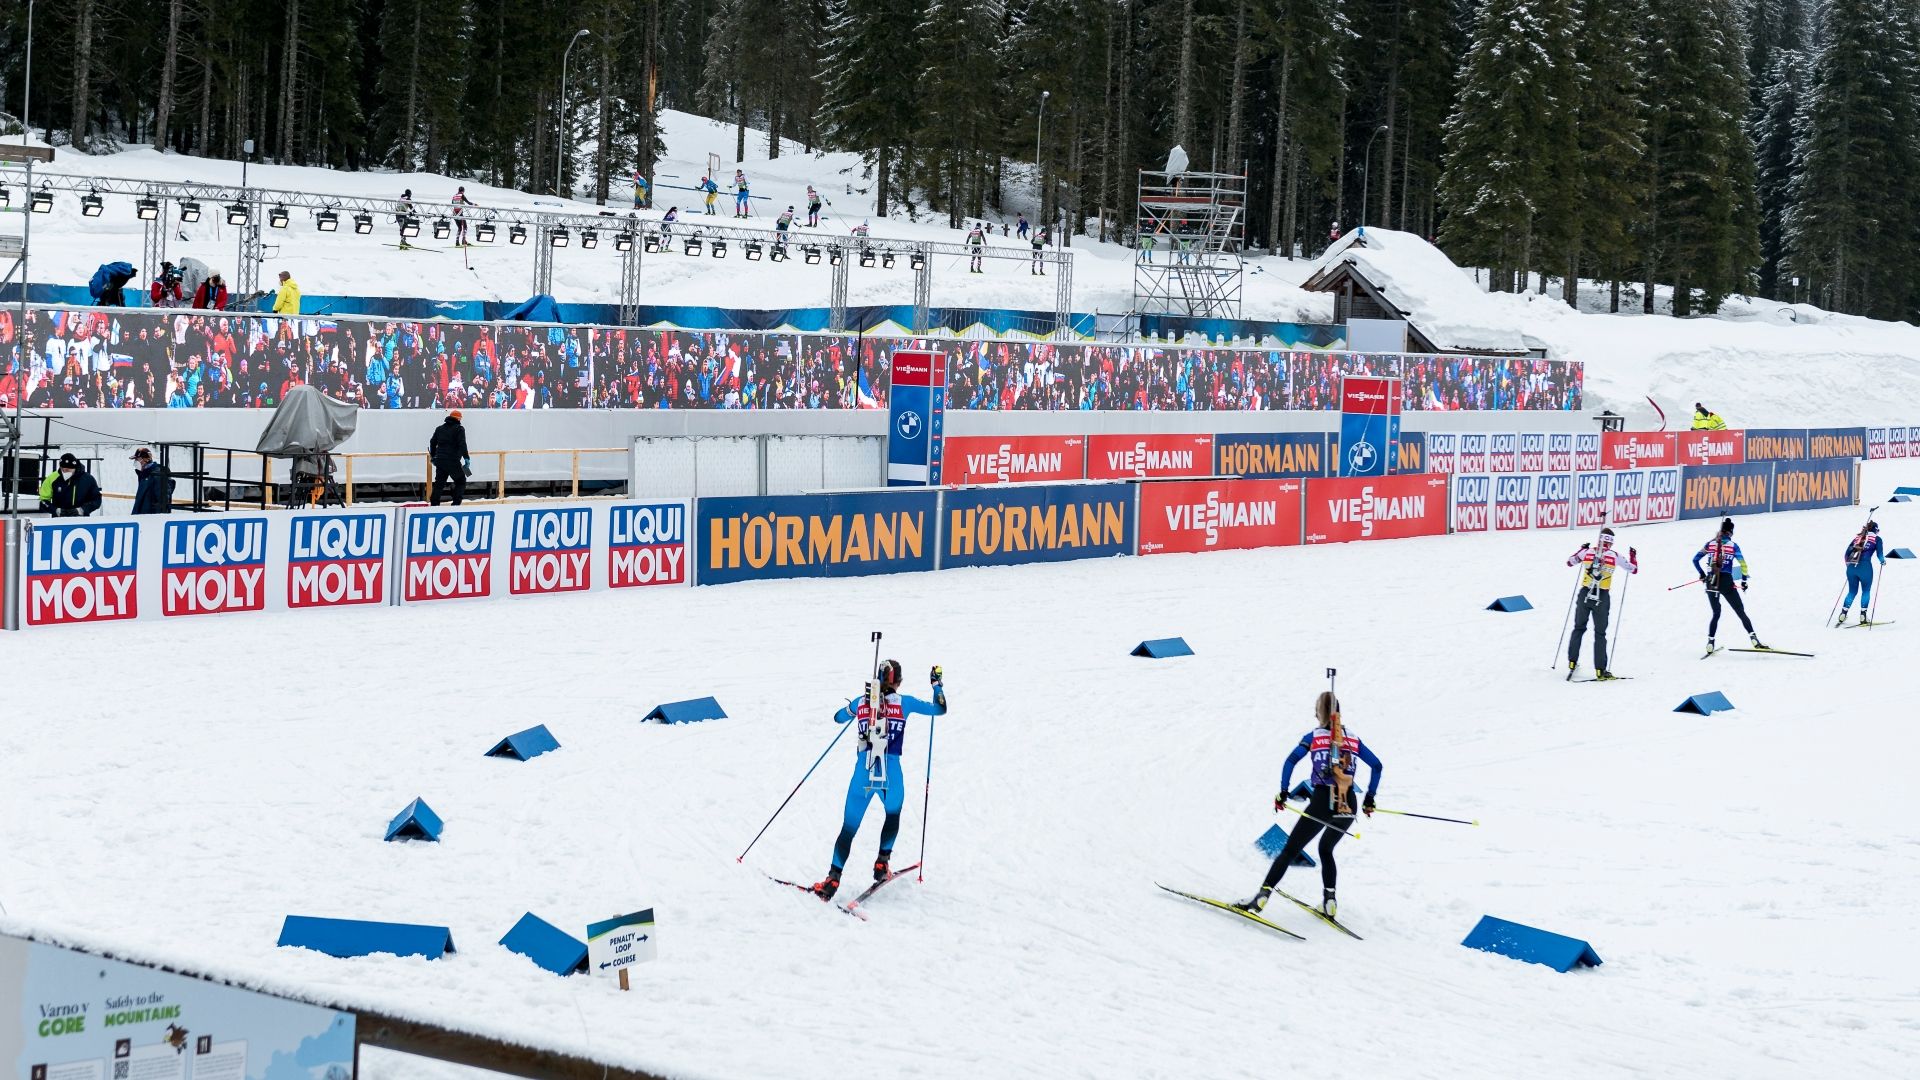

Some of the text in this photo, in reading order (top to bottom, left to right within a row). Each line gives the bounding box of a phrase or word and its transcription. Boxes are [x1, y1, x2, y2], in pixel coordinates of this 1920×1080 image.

[896, 365, 928, 374] VIESSMANN
[1430, 436, 1455, 454] LIQUI
[1461, 436, 1486, 454] LIQUI
[1491, 435, 1515, 453] LIQUI
[1521, 435, 1544, 452] LIQUI
[1549, 435, 1571, 452] LIQUI
[1577, 435, 1597, 452] LIQUI
[1810, 435, 1863, 458] HÖRMANN
[1870, 430, 1885, 443] LIQUI
[1890, 429, 1905, 442] LIQUI
[1107, 441, 1193, 477] VIESSMANN
[1220, 442, 1319, 475] HÖRMANN
[1613, 437, 1664, 468] VIESSMANN
[1688, 436, 1733, 465] VIESSMANN
[1748, 435, 1804, 460] HÖRMANN
[1870, 444, 1885, 458] MOLY
[1890, 443, 1905, 458] MOLY
[967, 444, 1062, 484] VIESSMANN
[1430, 455, 1454, 473] MOLY
[1461, 455, 1484, 472] MOLY
[1491, 455, 1514, 472] MOLY
[1521, 454, 1543, 471] MOLY
[1549, 454, 1570, 471] MOLY
[1576, 454, 1597, 470] MOLY
[1458, 478, 1488, 503] LIQUI
[1497, 478, 1530, 502] LIQUI
[1538, 477, 1570, 501] LIQUI
[1579, 476, 1607, 499] LIQUI
[1615, 473, 1642, 496] LIQUI
[1648, 472, 1676, 494] LIQUI
[1685, 474, 1767, 510] HÖRMANN
[1776, 469, 1849, 504] HÖRMANN
[1165, 491, 1276, 546] VIESSMANN
[1328, 486, 1425, 537] VIESSMANN
[1457, 505, 1487, 530] MOLY
[1496, 505, 1528, 529] MOLY
[1537, 503, 1569, 526] MOLY
[1614, 499, 1640, 521] MOLY
[1647, 496, 1675, 518] MOLY
[410, 515, 490, 555] LIQUI
[515, 511, 589, 549] LIQUI
[612, 507, 682, 544] LIQUI
[950, 501, 1125, 556] HÖRMANN
[32, 527, 134, 572] LIQUI
[168, 522, 264, 566] LIQUI
[292, 518, 382, 559] LIQUI
[710, 510, 925, 569] HÖRMANN
[513, 552, 590, 591] MOLY
[612, 546, 684, 583] MOLY
[292, 562, 383, 604] MOLY
[409, 557, 490, 597] MOLY
[32, 574, 136, 621] MOLY
[167, 568, 264, 612] MOLY
[609, 932, 636, 947] PENALTY
[615, 943, 632, 954] LOOP
[612, 954, 636, 967] COURSE
[40, 1003, 79, 1018] Varno
[105, 991, 165, 1010] Safely to the
[38, 1016, 86, 1038] GORE
[104, 1005, 182, 1028] MOUNTAINS
